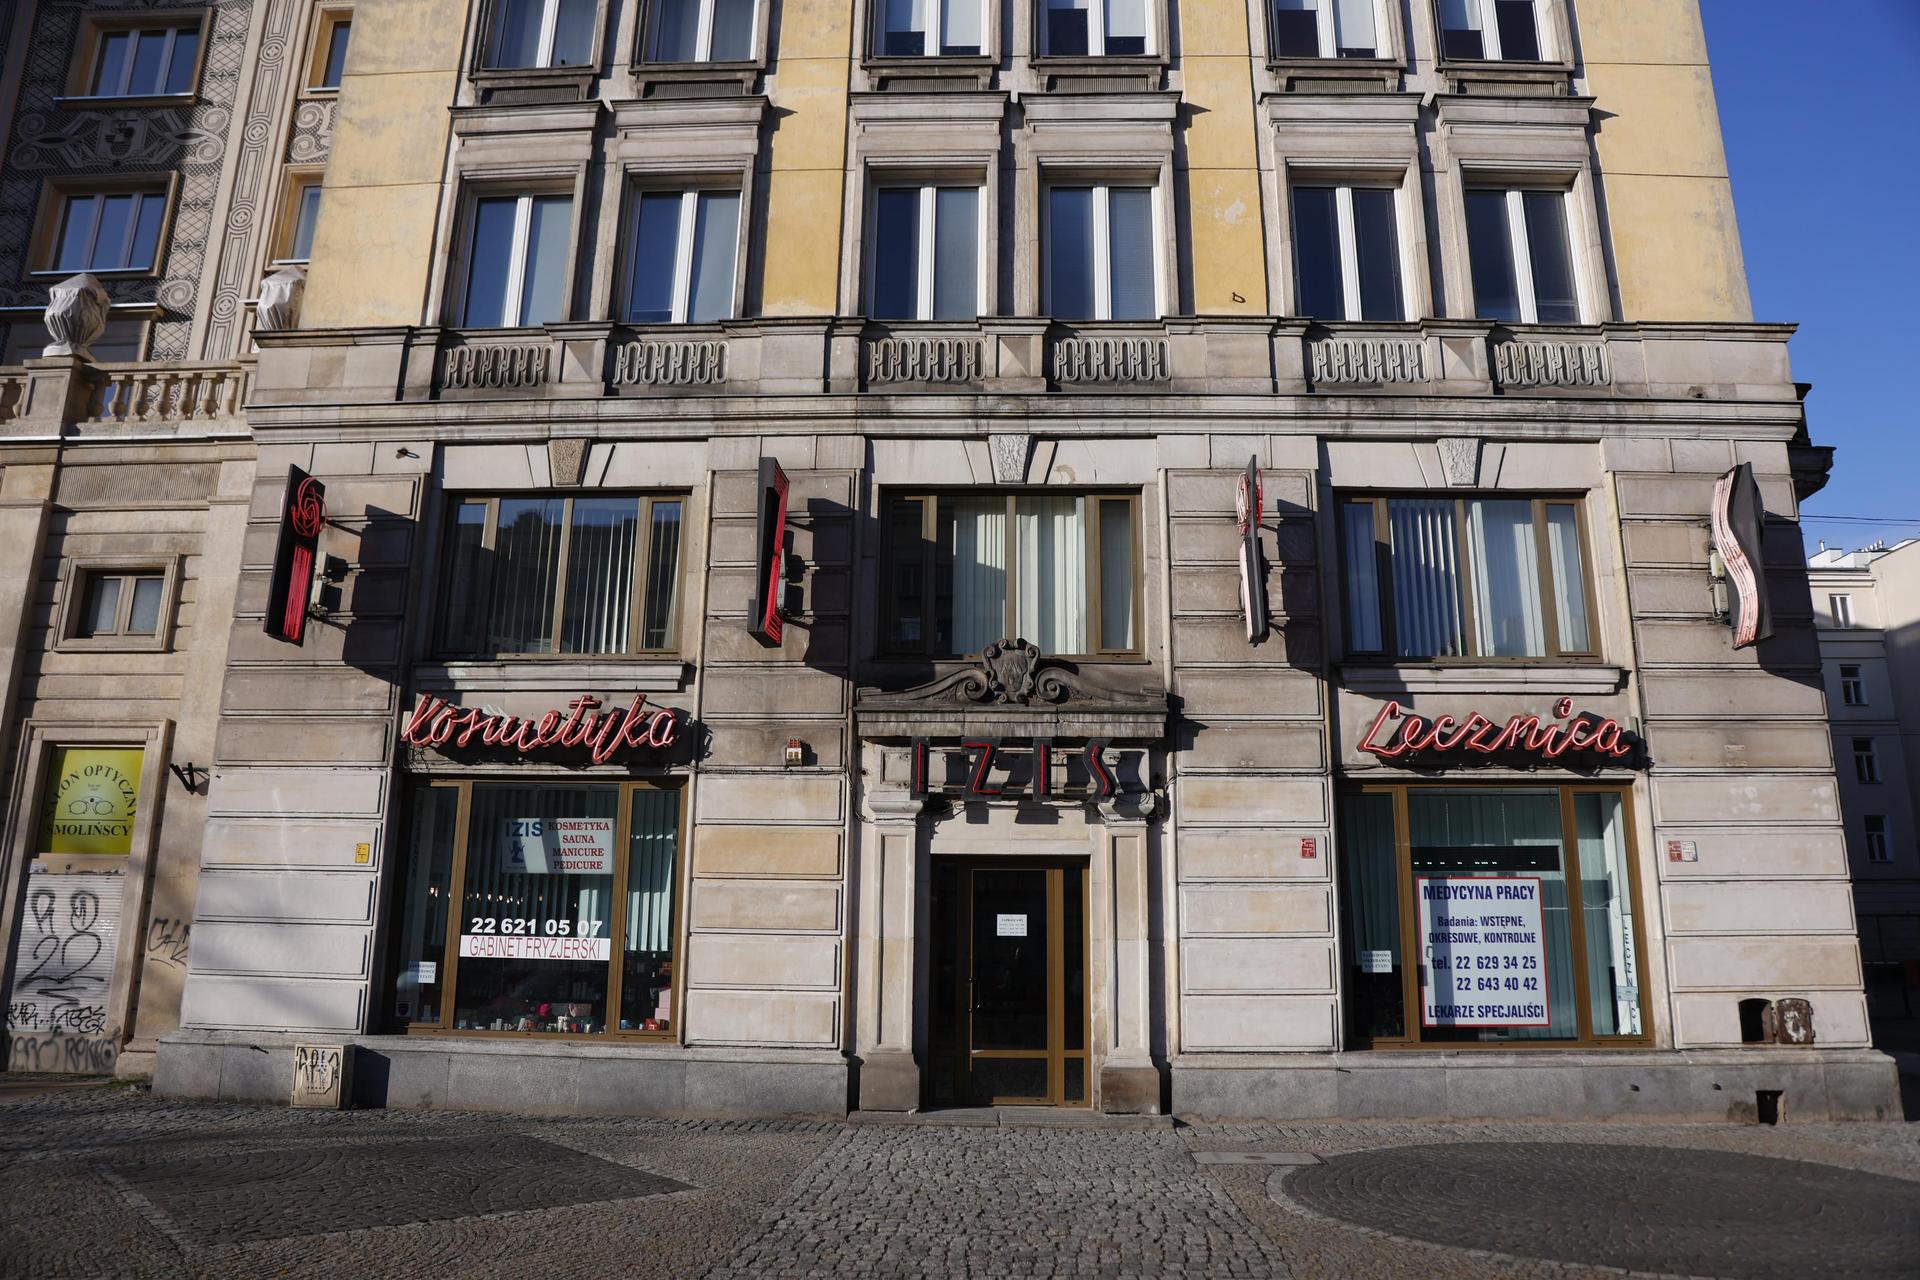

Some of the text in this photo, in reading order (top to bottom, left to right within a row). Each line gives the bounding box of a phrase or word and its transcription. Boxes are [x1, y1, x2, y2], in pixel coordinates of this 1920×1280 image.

[402, 694, 678, 763] Kosmetyka
[1357, 697, 1630, 758] Lecznica
[911, 736, 1116, 801] IZIS
[84, 765, 137, 817] OPTYCZNY
[505, 822, 544, 837] IZIS
[548, 822, 610, 831] KOSMETYKA
[562, 835, 595, 844] SAUNA
[553, 848, 605, 857] MANICURE
[553, 861, 603, 870] PEDICURE
[1423, 885, 1535, 900] MEDYCYNA PRACY
[470, 917, 603, 937] 22 621 05 07
[1438, 916, 1526, 928] Badania: WSTĘPNE,
[1428, 932, 1537, 944] OKRESOWE, KONTROLNE
[469, 936, 601, 959] GABINET FRYZJERSKI
[1432, 956, 1537, 970] tel. 22 629 34 25
[1456, 977, 1538, 991] 22 643 40 42
[1428, 1002, 1545, 1018] LEKARZE SPECJALIŚCI
